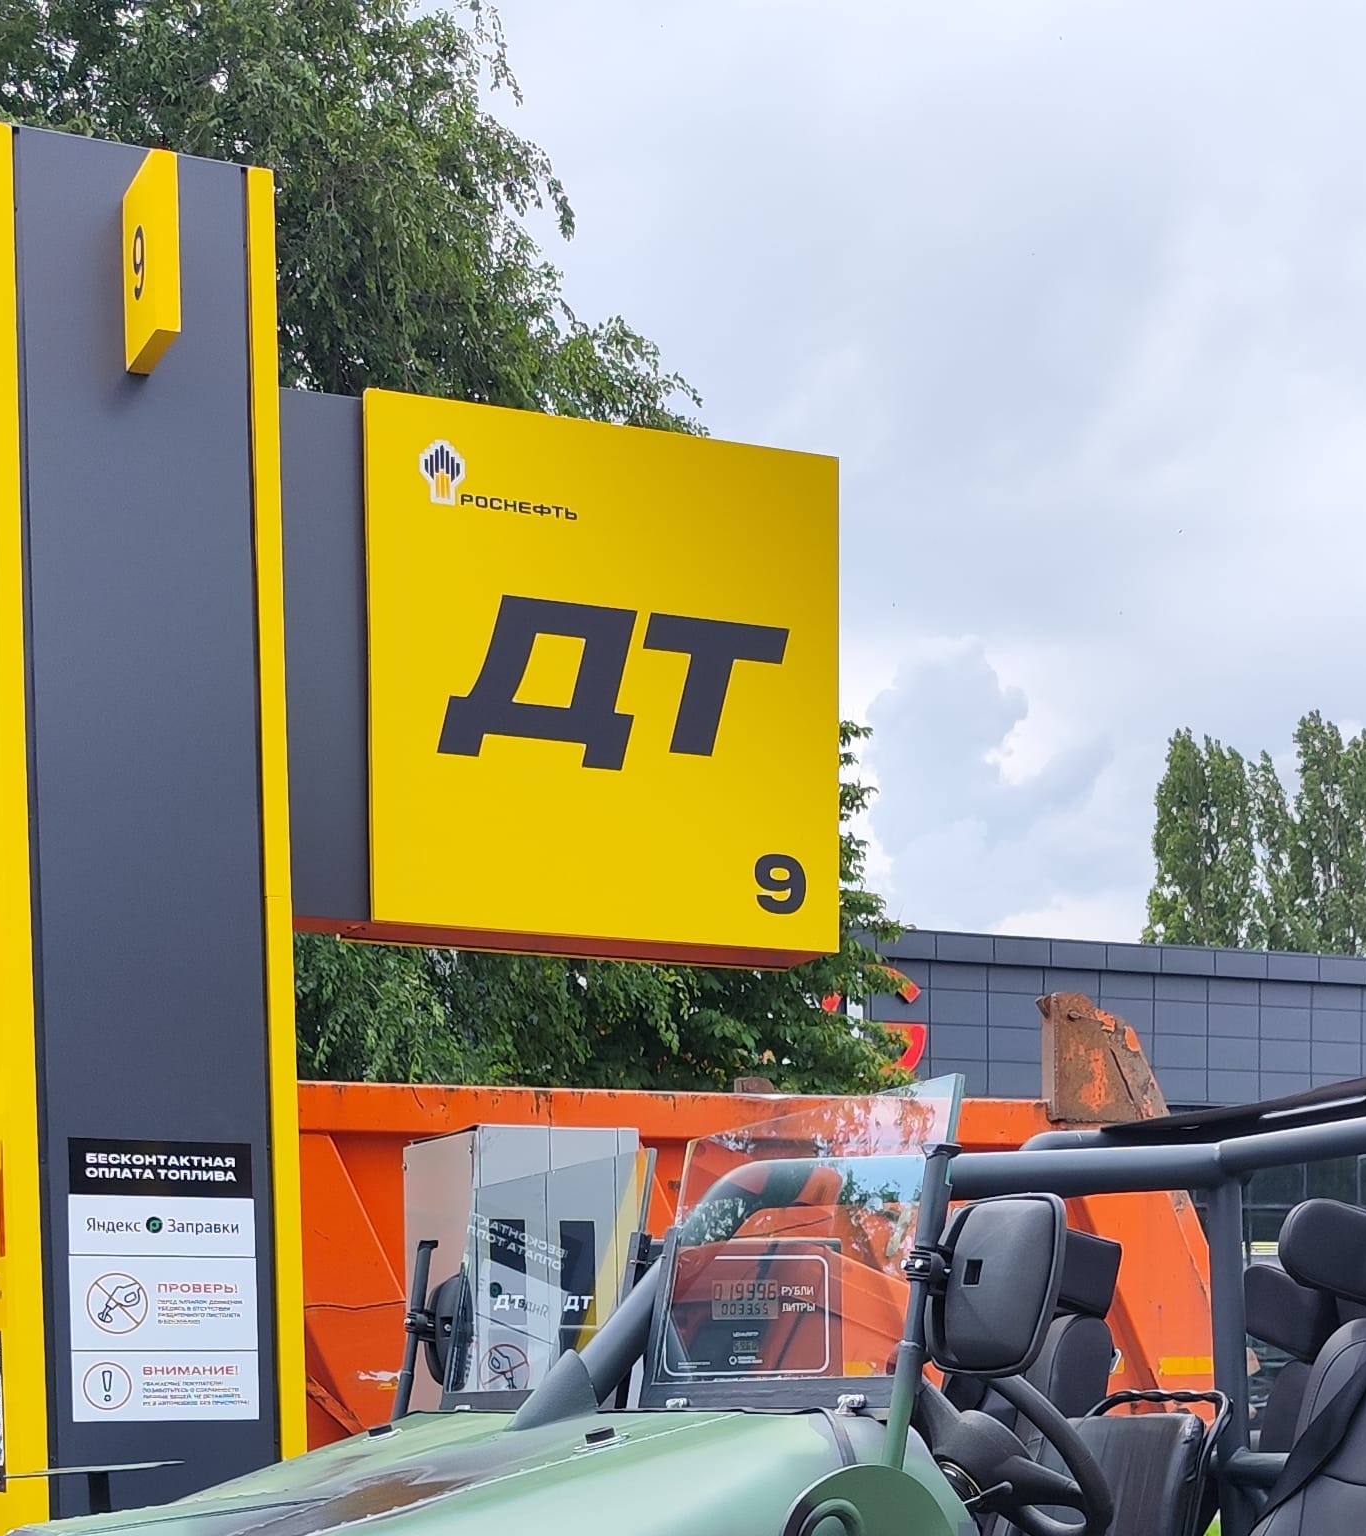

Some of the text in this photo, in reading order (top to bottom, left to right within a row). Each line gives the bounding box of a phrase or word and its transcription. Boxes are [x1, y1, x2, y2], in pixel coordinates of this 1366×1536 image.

[132, 224, 145, 301] 9
[460, 493, 578, 521] РОСНЕФТЬ
[437, 594, 790, 771] ДТ
[754, 853, 807, 915] 9
[85, 1152, 236, 1168] БЕСКОНТАКТНАЯ
[85, 1167, 237, 1182] ОПЛАТА ТОПЛИВА
[86, 1217, 240, 1236] Яндекс Заправки
[157, 1283, 238, 1294] ПРОВЕРЬ!
[781, 1285, 815, 1297] РУБЛИ
[493, 1294, 526, 1312] ДТ
[563, 1294, 595, 1312] ДТ
[781, 1302, 816, 1313] ЛИТРЫ
[142, 1365, 239, 1376] ВНИМАНИЕ!
